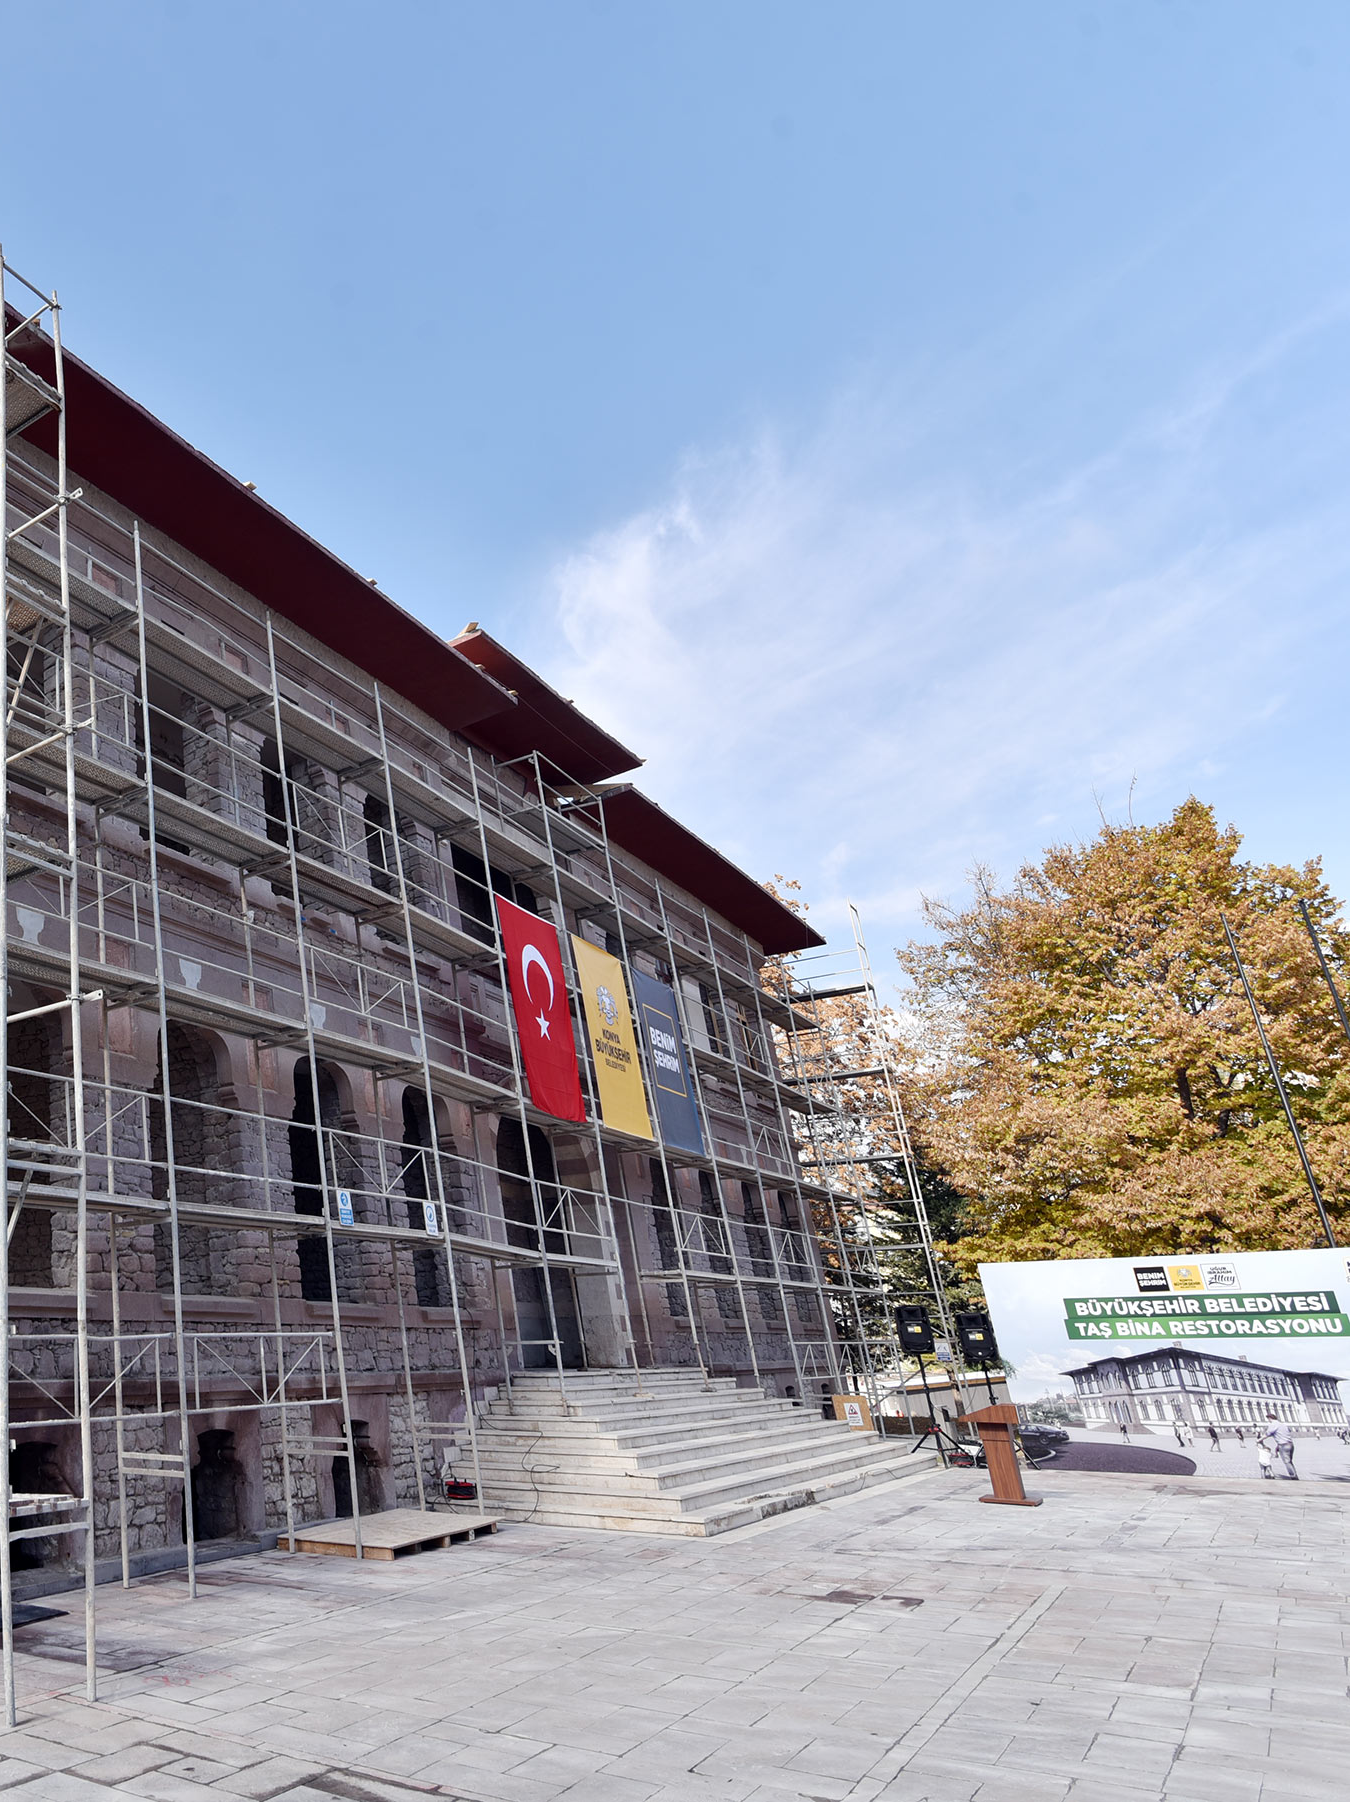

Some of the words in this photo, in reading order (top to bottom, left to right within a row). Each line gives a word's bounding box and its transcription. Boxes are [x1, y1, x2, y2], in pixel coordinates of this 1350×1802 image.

[602, 1028, 621, 1045] KONYA
[1074, 1296, 1201, 1317] BÜYÜKŞEHİR
[1204, 1292, 1330, 1313] BELEDİYESİ
[1074, 1322, 1113, 1338] TAŞ
[1115, 1319, 1166, 1336] BİNA
[1168, 1317, 1343, 1336] RESTORASYONU
